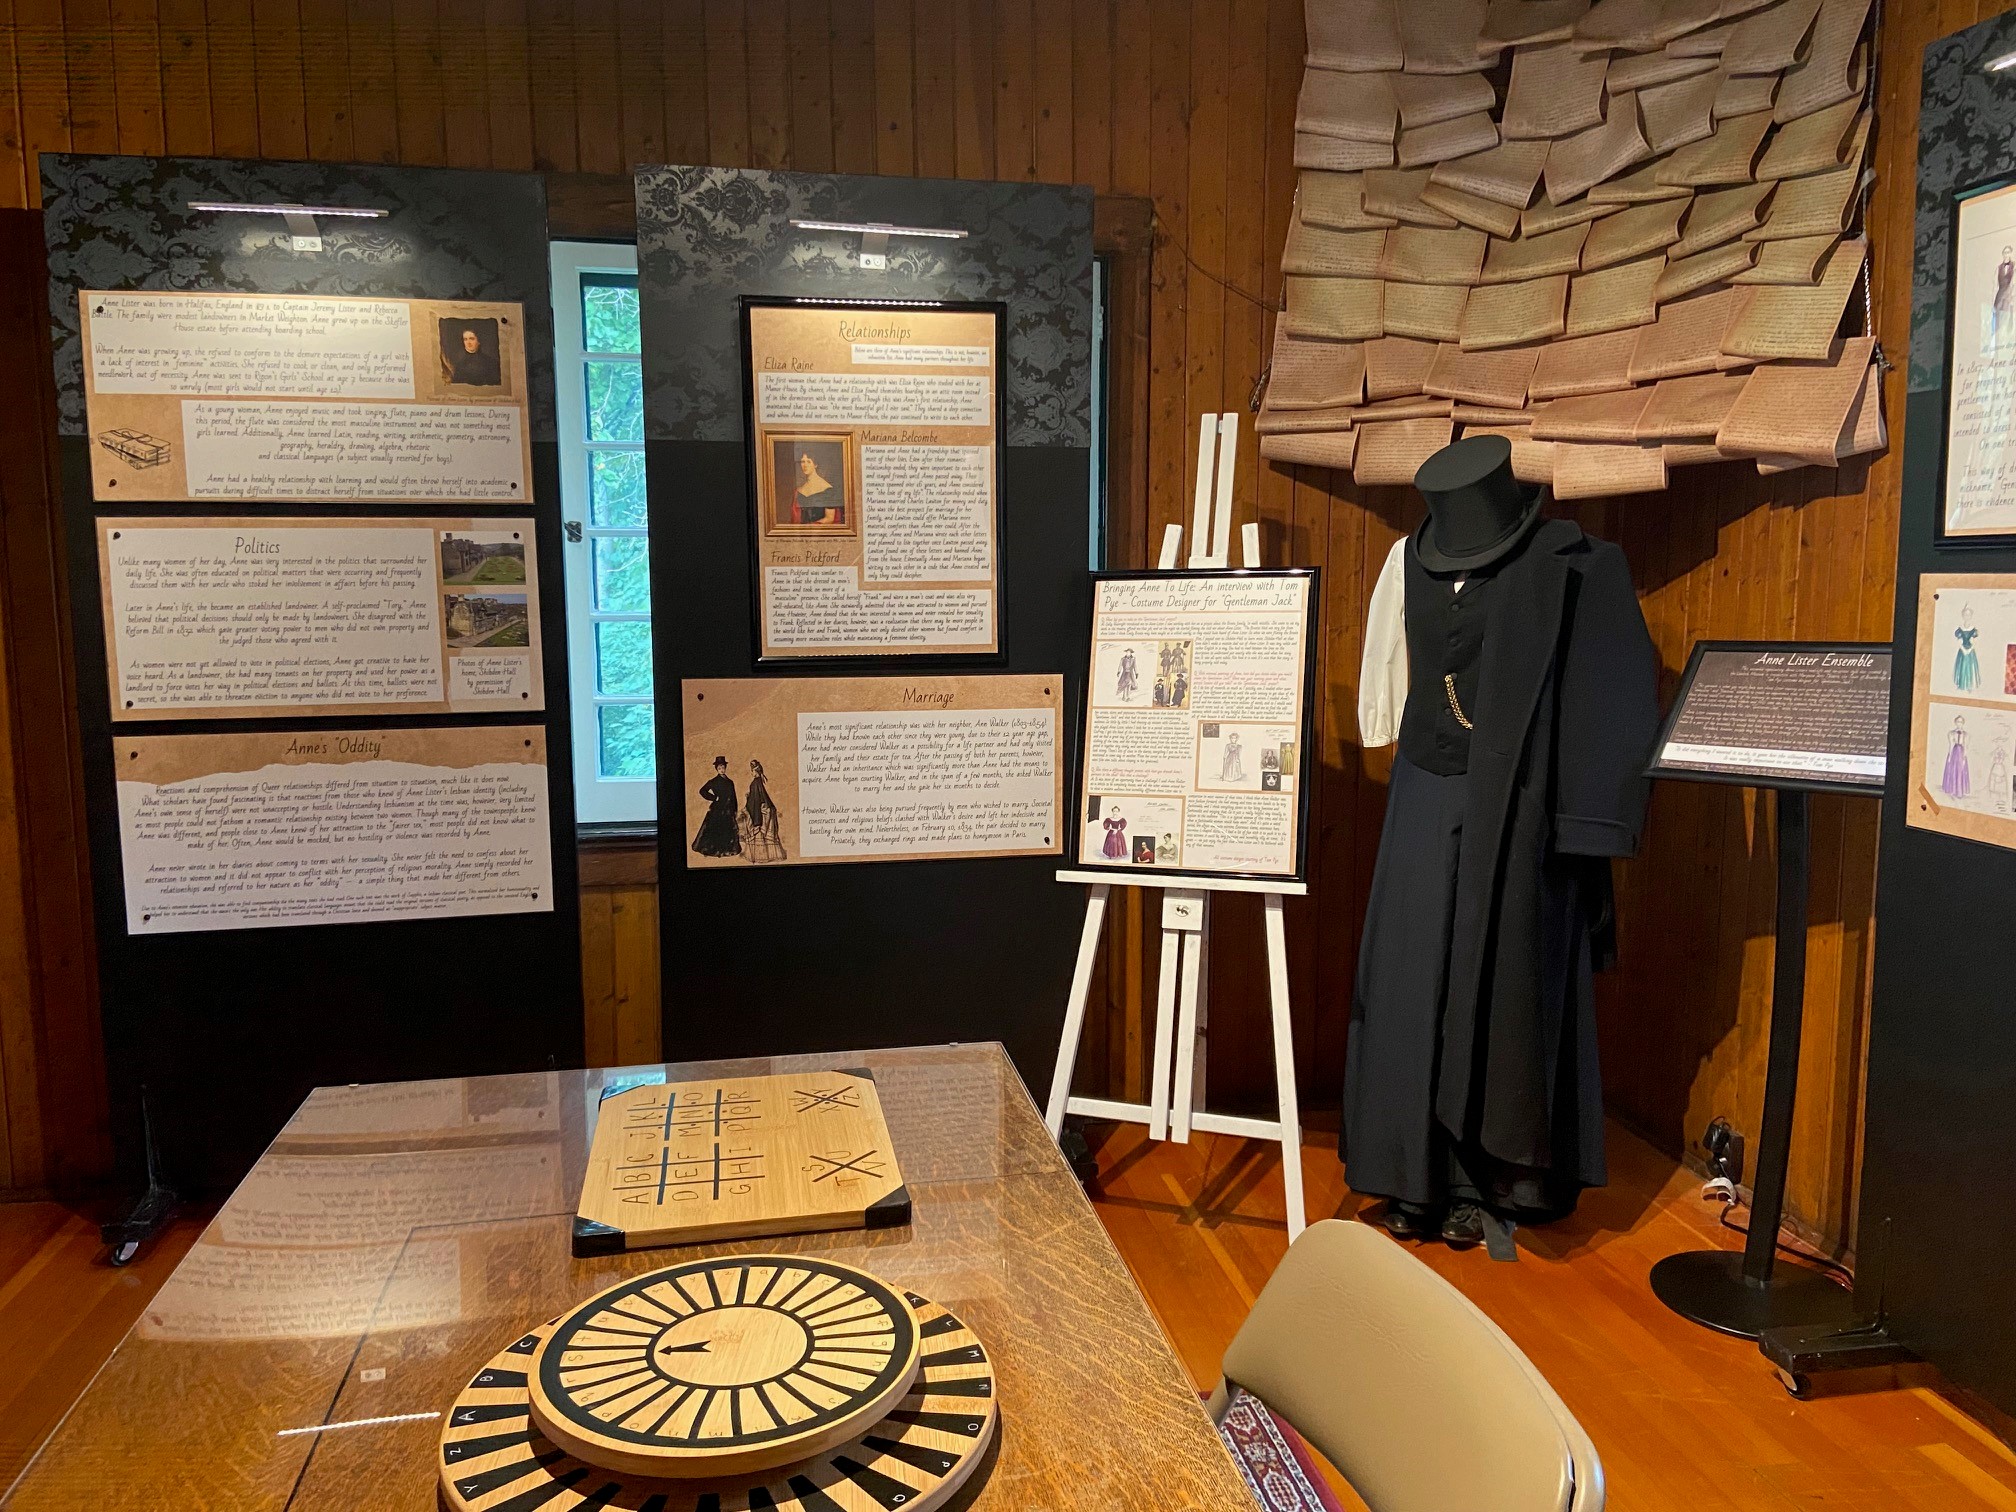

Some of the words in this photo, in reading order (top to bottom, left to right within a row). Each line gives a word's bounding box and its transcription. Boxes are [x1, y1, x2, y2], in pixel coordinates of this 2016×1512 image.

[839, 321, 911, 344] Relationships
[765, 357, 787, 370] Eliza
[791, 357, 814, 373] Raine
[861, 430, 897, 442] Mariana
[901, 430, 937, 442] Belcombe
[1998, 463, 2006, 480] of
[1986, 495, 2014, 506] evidence
[235, 537, 280, 553] Politics
[772, 551, 800, 562] Francis
[806, 551, 840, 566] Pickford
[1103, 582, 1136, 596] Bringing
[1138, 582, 1160, 592] Anne
[1165, 582, 1175, 591] To
[1178, 581, 1195, 595] Life:
[1200, 581, 1213, 591] An
[1217, 581, 1252, 591] interview
[1257, 580, 1274, 590] with
[1280, 579, 1298, 590] Tom
[1105, 597, 1119, 611] Pye
[1131, 596, 1163, 607] Costume
[1167, 595, 1200, 610] Designer
[1200, 595, 1217, 610] for
[1222, 594, 1268, 610] "Gentleman
[1271, 594, 1296, 606] Jack"
[1754, 653, 1784, 665] Anne
[1788, 653, 1818, 665] Lister
[1822, 653, 1874, 667] Ensemble
[903, 688, 954, 708] Marriage
[807, 721, 826, 729] Anne's
[844, 721, 872, 731] significant
[875, 720, 907, 731] relationship
[922, 720, 935, 728] with
[937, 719, 946, 727] her
[974, 719, 986, 727] Ann
[989, 718, 1009, 727] Walker
[285, 738, 327, 755] Anne's
[336, 736, 386, 758] "Oddity"
[728, 1091, 748, 1099] R
[633, 1098, 655, 1106] L
[789, 1098, 808, 1106] W
[679, 1110, 703, 1118] N
[731, 1106, 751, 1114] Q
[630, 1112, 656, 1121] K
[678, 1126, 701, 1137] M
[627, 1154, 653, 1162] C
[826, 1151, 851, 1160] U
[731, 1163, 750, 1174] H
[862, 1161, 886, 1170] V
[624, 1173, 650, 1182] B
[675, 1169, 697, 1179] E
[835, 1176, 860, 1186] T
[729, 1184, 750, 1194] G
[622, 1193, 648, 1204] A
[672, 1191, 698, 1201] D
[458, 1411, 476, 1421] A
[464, 1484, 478, 1492] Y
